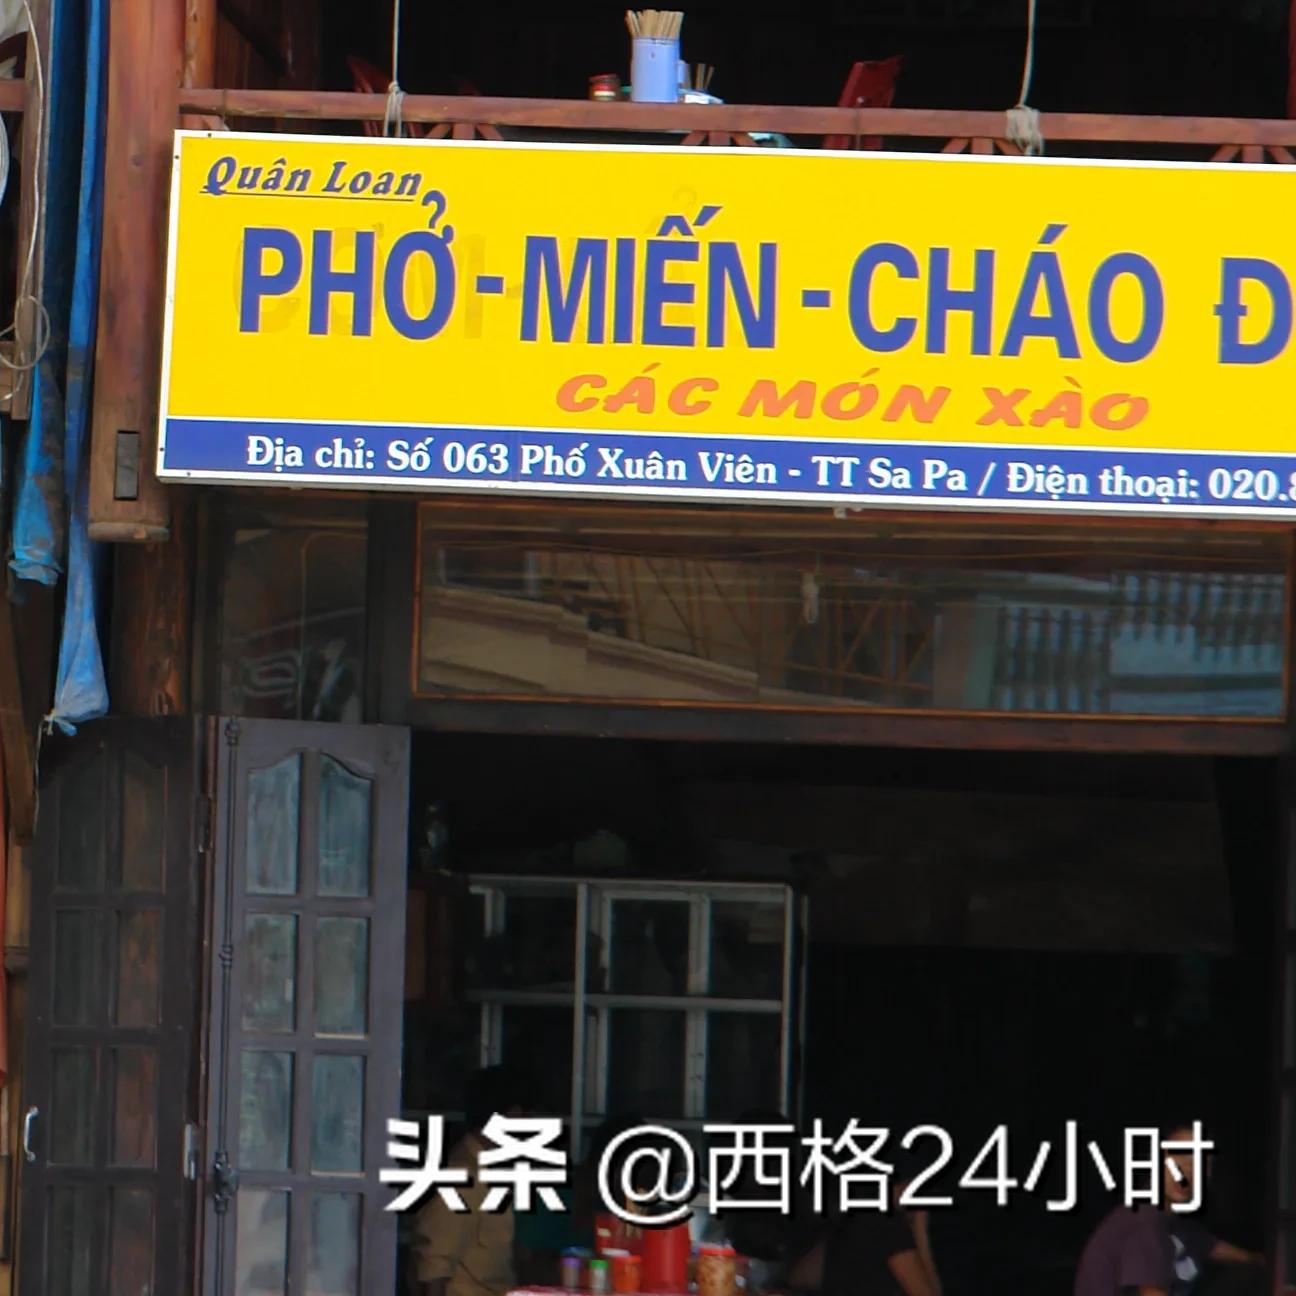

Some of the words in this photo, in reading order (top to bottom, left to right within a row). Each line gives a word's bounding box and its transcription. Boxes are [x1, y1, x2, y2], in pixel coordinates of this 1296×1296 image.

[322, 161, 422, 196] Loan
[238, 189, 457, 341] PHỞ
[519, 205, 778, 349] MIẾN
[847, 223, 1165, 364] CHÁO
[1213, 256, 1295, 365] Đ
[556, 362, 720, 416] CÁC
[738, 367, 953, 425] MÓN
[975, 376, 1152, 431] XÀO
[247, 435, 305, 473] Địa
[314, 438, 376, 471] chỉ:
[386, 437, 435, 474] Số
[443, 442, 509, 475] 063
[519, 443, 587, 479] Phố
[597, 447, 688, 482] Xuân
[698, 451, 778, 485] Viên
[811, 455, 860, 487] TT
[867, 458, 912, 491] Sa
[922, 459, 968, 493] Pa
[1007, 461, 1090, 501] Điện
[1098, 465, 1201, 503] thoại:
